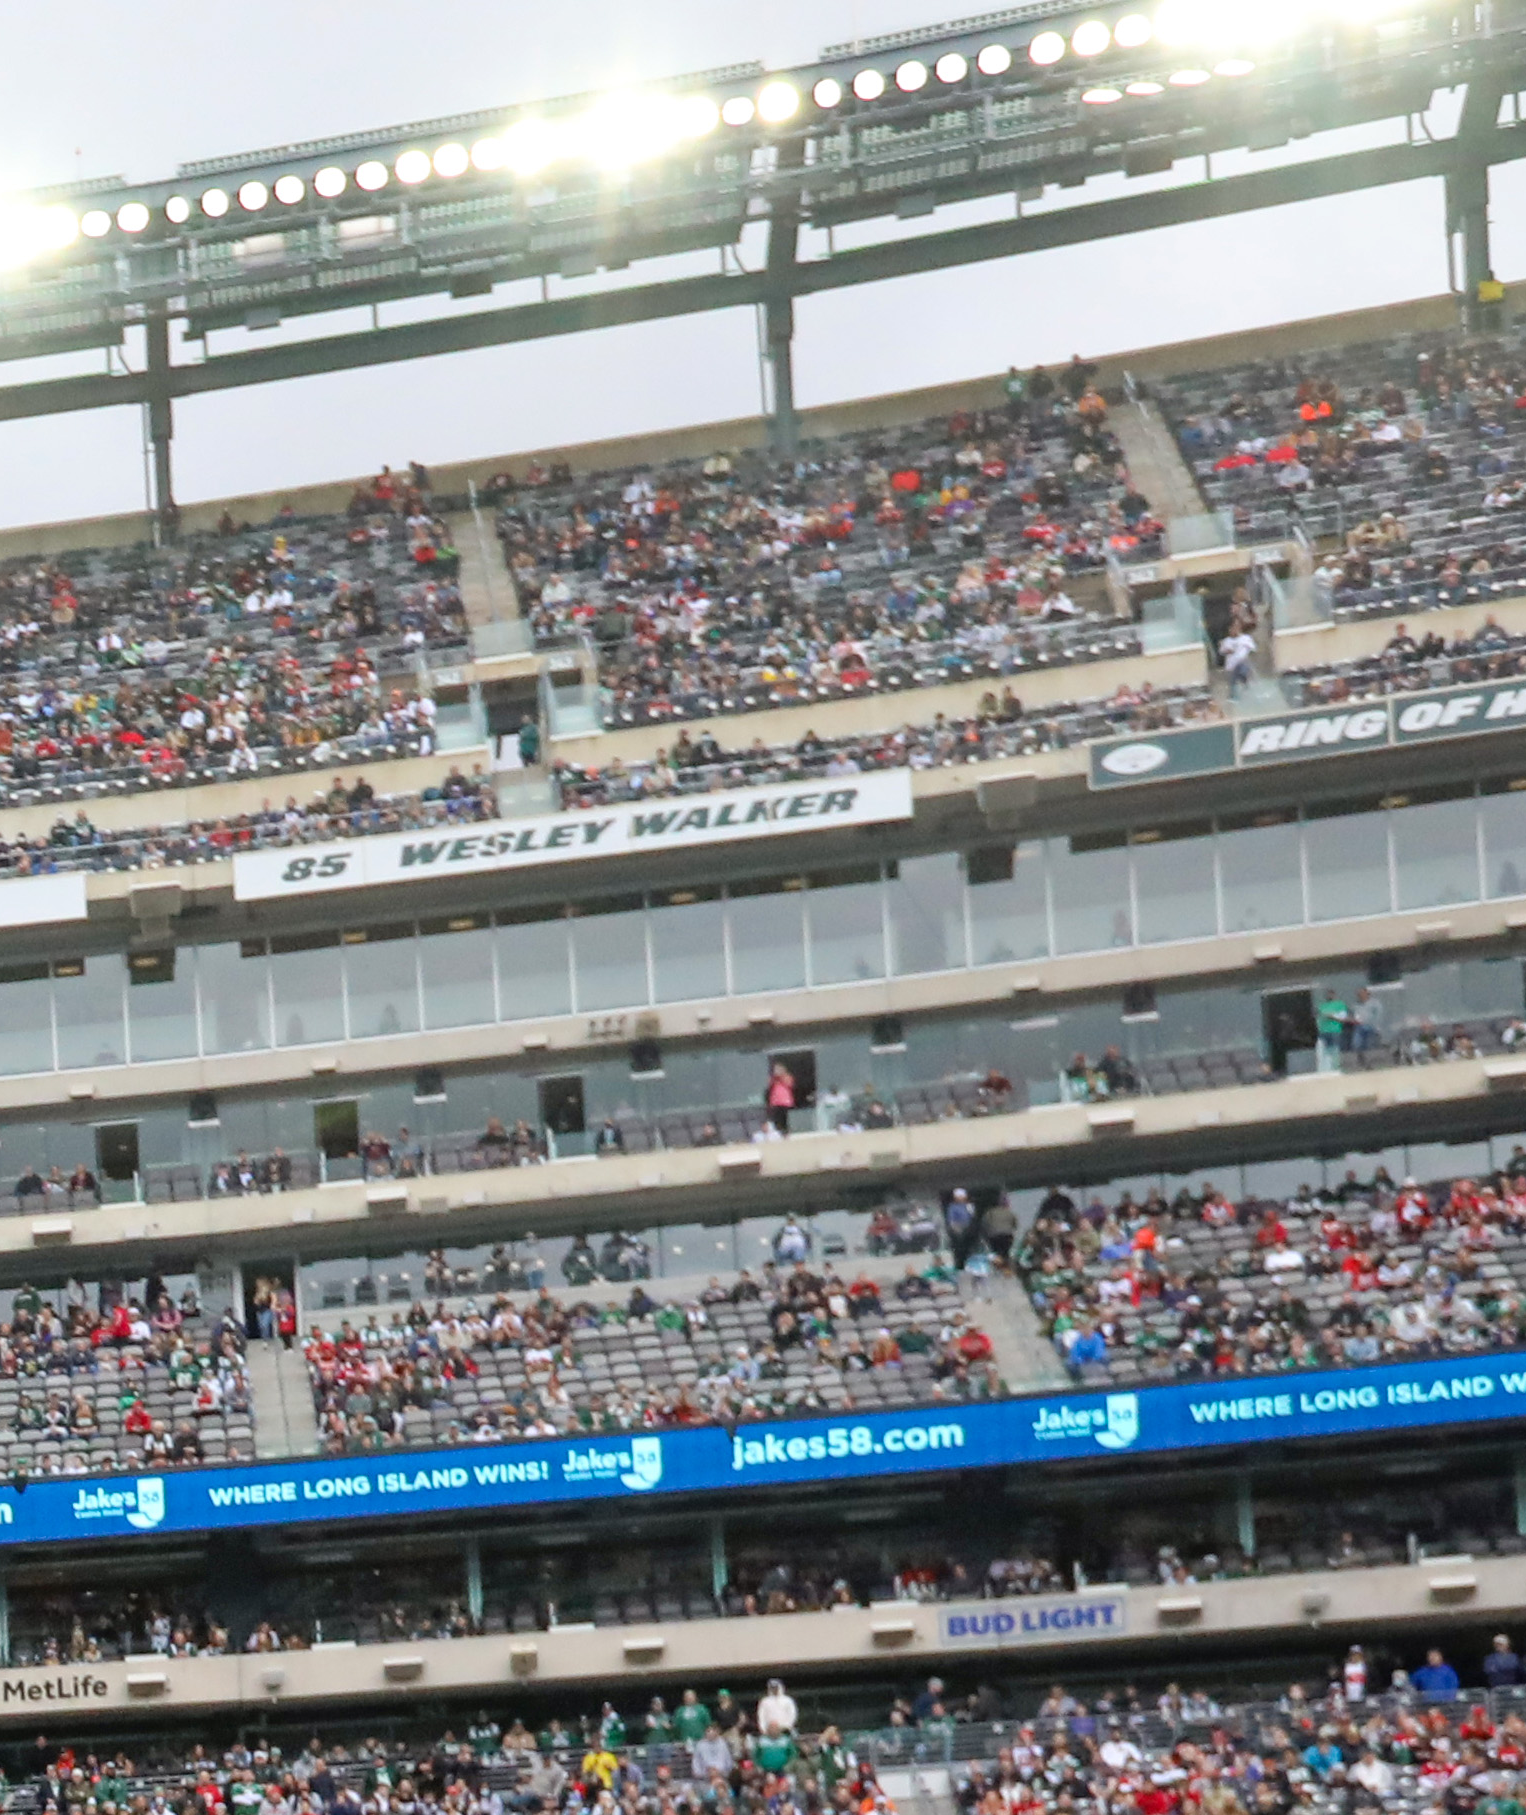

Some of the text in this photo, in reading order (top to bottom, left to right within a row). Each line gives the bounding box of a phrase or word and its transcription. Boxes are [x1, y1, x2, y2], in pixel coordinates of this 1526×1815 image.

[1239, 709, 1390, 757] RING
[1398, 696, 1484, 733] OF
[281, 788, 860, 882] 85 WESLEY WALKER
[1191, 1394, 1294, 1424] WHERE
[1300, 1386, 1380, 1415] LONG
[1387, 1375, 1497, 1409] ISLAND
[562, 1448, 631, 1472] Jake's
[732, 1421, 965, 1472] jakes58.com
[72, 1488, 137, 1511] Jake's
[208, 1460, 550, 1507] WHERE LONG ISLAND WINS!
[947, 1602, 1118, 1639] BUD LIGHT
[1, 1675, 109, 1702] MetLife
